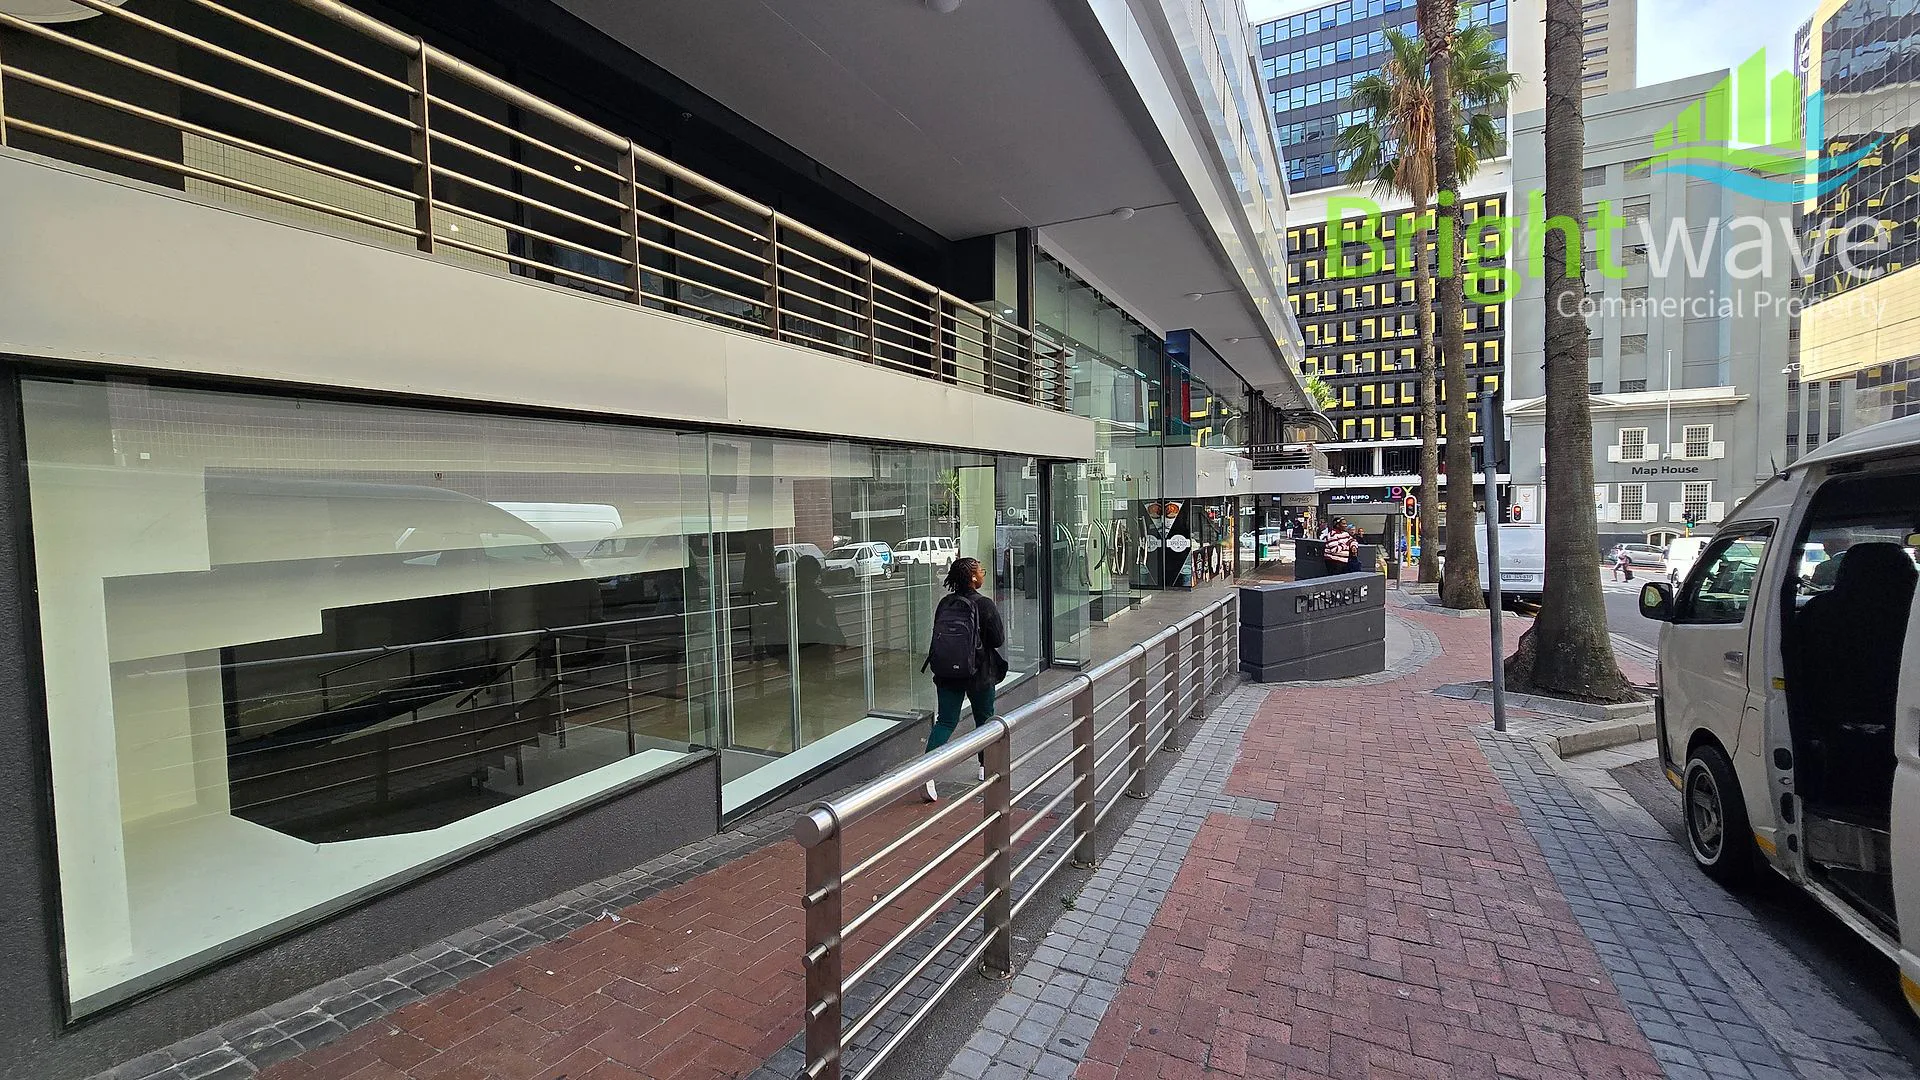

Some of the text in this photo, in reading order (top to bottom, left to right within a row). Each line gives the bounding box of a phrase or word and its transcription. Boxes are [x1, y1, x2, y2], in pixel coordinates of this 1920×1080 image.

[1631, 465, 1699, 476] Map House
[1384, 486, 1413, 499] JOY
